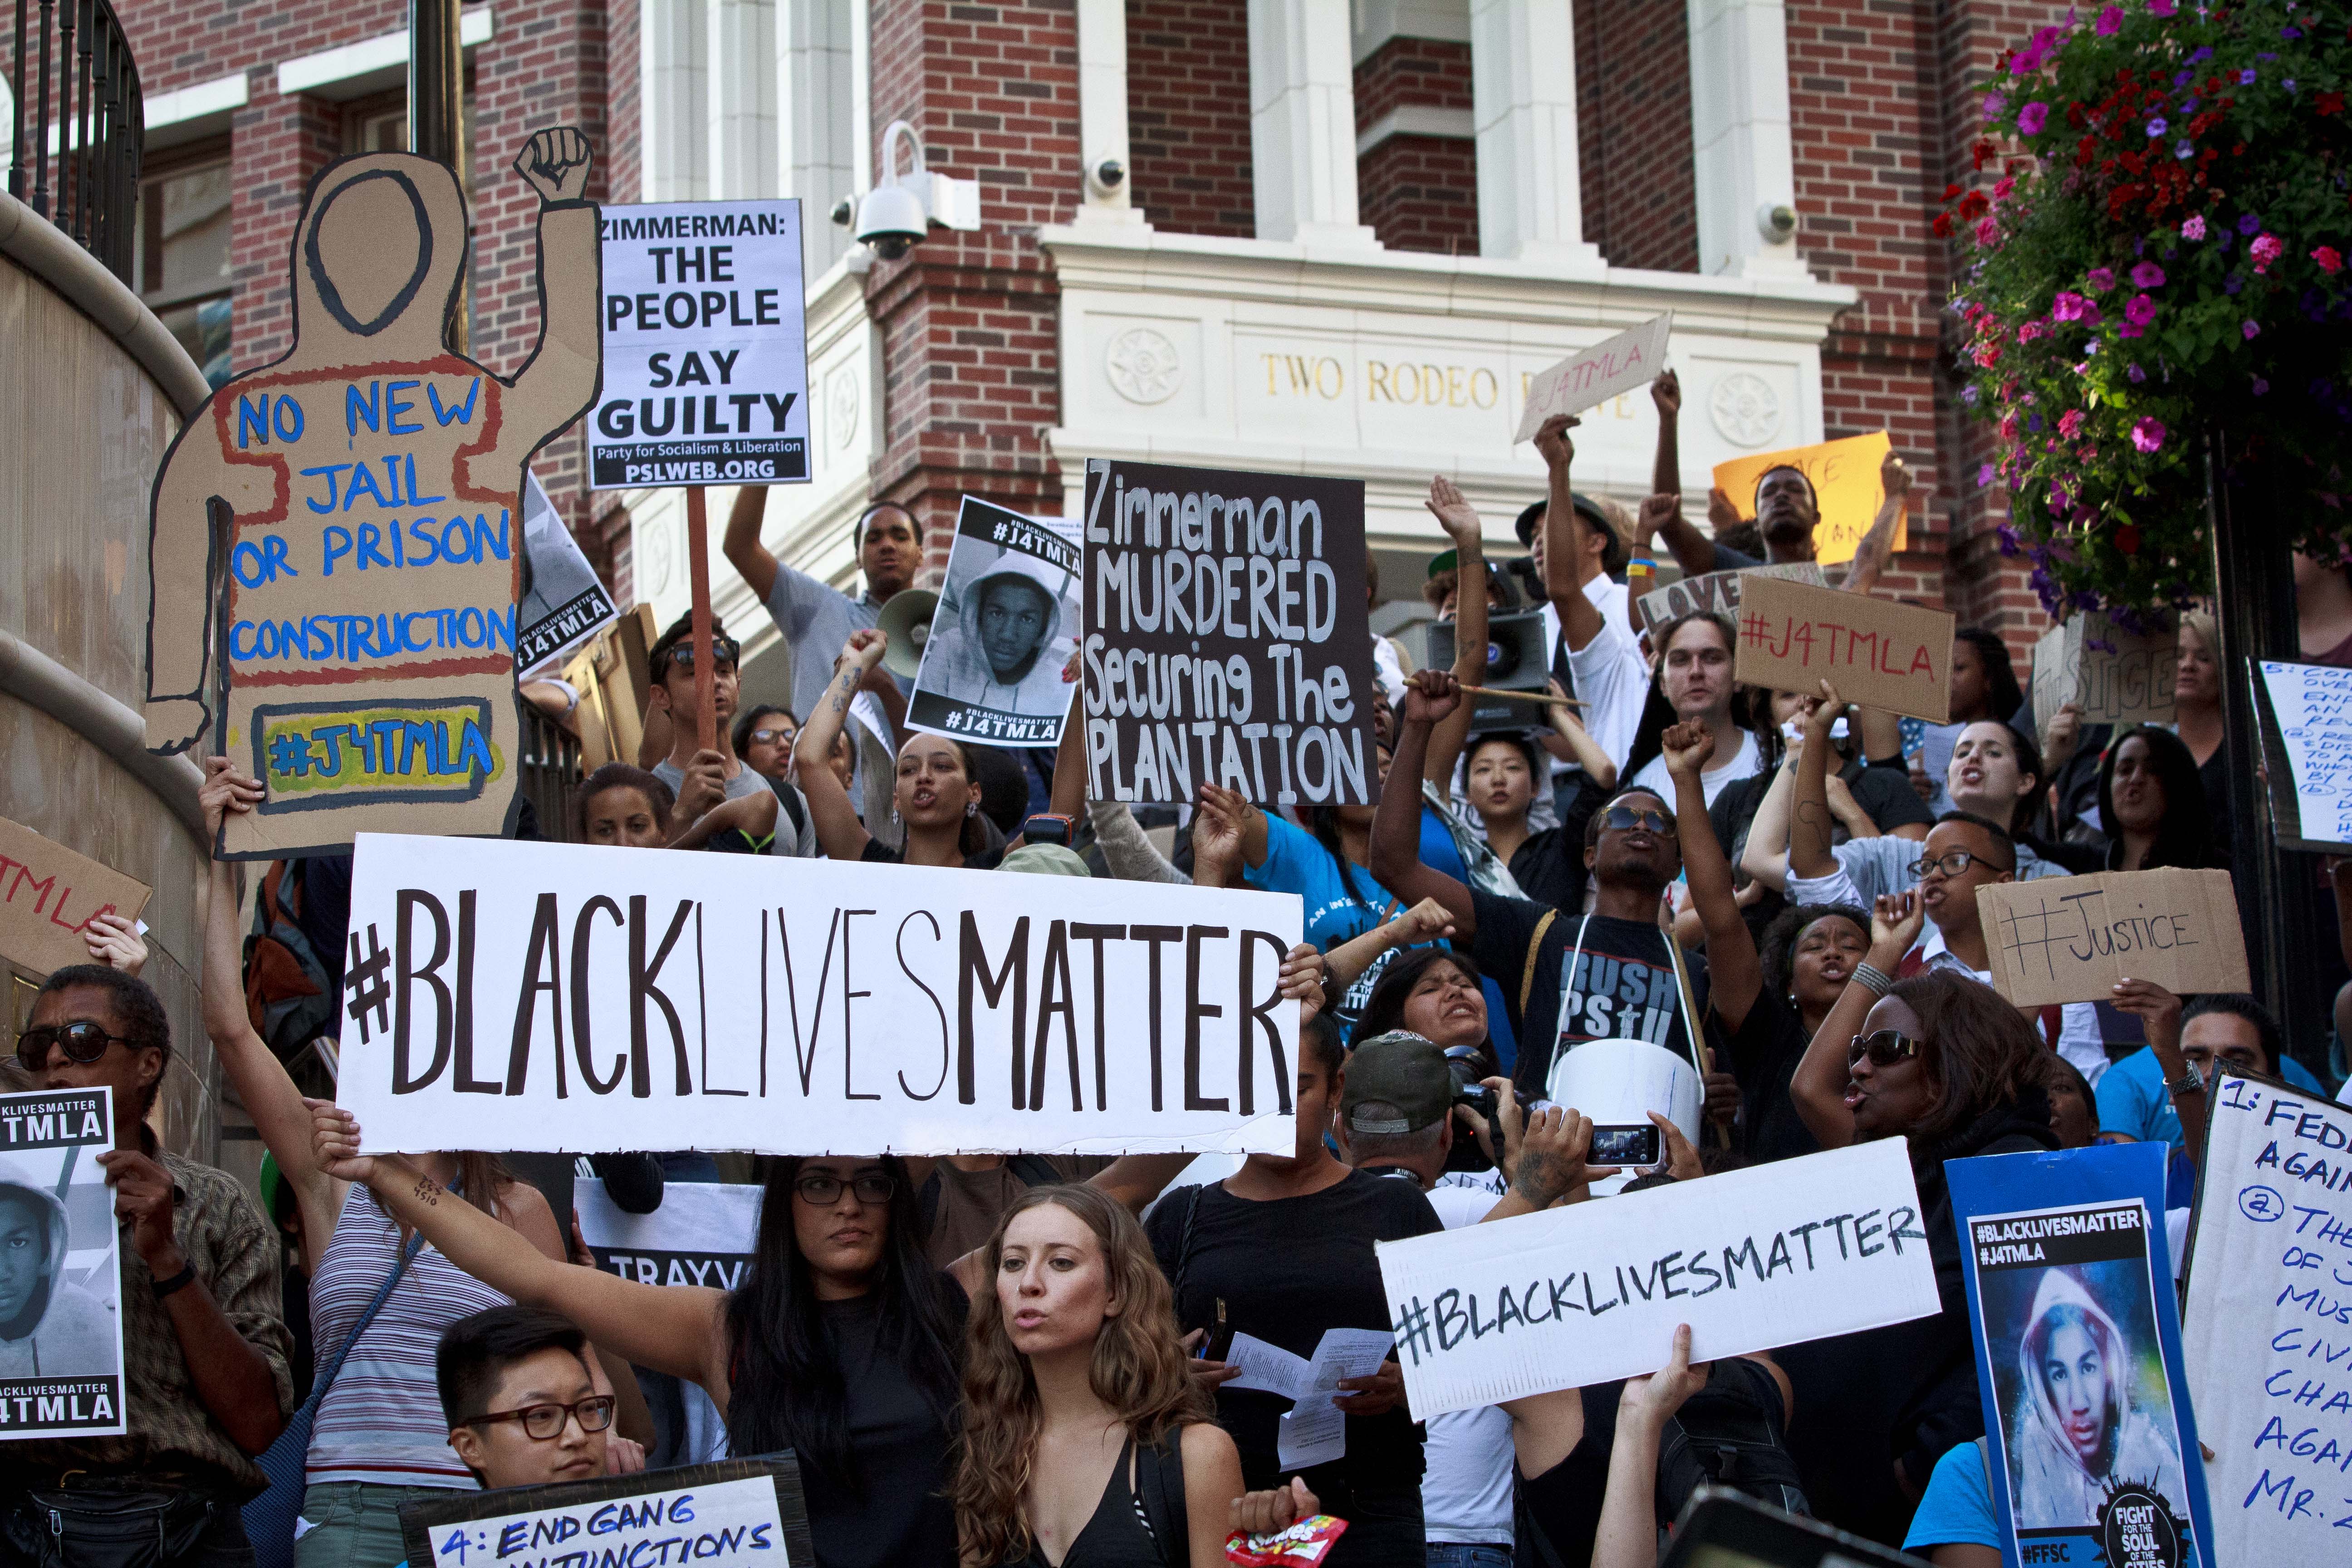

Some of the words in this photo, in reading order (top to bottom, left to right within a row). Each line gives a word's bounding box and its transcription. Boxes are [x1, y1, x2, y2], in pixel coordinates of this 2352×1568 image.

[602, 214, 785, 240] ZIMMERMAN:
[648, 245, 735, 284] THE
[607, 289, 780, 331] PEOPLE
[648, 349, 740, 387] SAY
[1260, 353, 1343, 401] TWO
[1368, 360, 1498, 410] RODEO
[238, 393, 304, 449] NO
[346, 377, 481, 437] NEW
[597, 392, 798, 439] GUILTY
[598, 447, 632, 461] Party
[636, 445, 654, 456] for
[658, 442, 719, 456] Socialism
[722, 442, 732, 453] &
[735, 440, 801, 453] Liberation
[626, 459, 775, 483] PSLWEB.ORG
[300, 453, 447, 514] JAIL
[1086, 459, 1322, 559] Zimmerman
[232, 535, 299, 589] OR
[323, 509, 510, 577] PRISON
[993, 522, 1081, 576] #J4TMLA
[1011, 519, 1081, 558] #BLACKLIVESMATTER
[1097, 548, 1337, 642] MURDERED
[1639, 572, 1740, 635] LOVE
[229, 602, 516, 663] CONSTRUCTION
[1741, 612, 1934, 682] #J4TMLA
[1085, 633, 1253, 725] Securing
[1268, 643, 1355, 724] The
[946, 711, 1055, 739] #J4TMLA
[966, 707, 1056, 726] #BLACKLIVESMATTER
[269, 718, 495, 776] #J4TMLA
[1088, 718, 1368, 805] PLANTATION
[344, 888, 1295, 1117] #BLACKLIVESMATTER
[1560, 950, 1677, 1014] RUSH
[0, 1100, 96, 1116] KLIVESMATTER
[0, 1111, 102, 1143] TMLA
[2264, 1099, 2352, 1154] FED
[1977, 1210, 2141, 1244] #BLACKLIVESMATTER
[609, 1255, 751, 1292] TRAYV
[1980, 1241, 2046, 1266] #J4TMLA
[2282, 1246, 2323, 1269] OF
[1392, 1205, 1928, 1367] #BLACKLIVESMATTER
[2115, 1505, 2154, 1525] FIGHT
[2243, 1469, 2324, 1521] MR.
[441, 1529, 486, 1566] 4:
[496, 1516, 581, 1560] END
[587, 1494, 696, 1536] GANG
[2121, 1533, 2160, 1552] SOUL
[2123, 1524, 2138, 1534] FOR
[2138, 1523, 2153, 1533] THE
[2022, 1543, 2071, 1564] #FFSC
[2130, 1552, 2140, 1561] OF
[2141, 1550, 2156, 1560] THE
